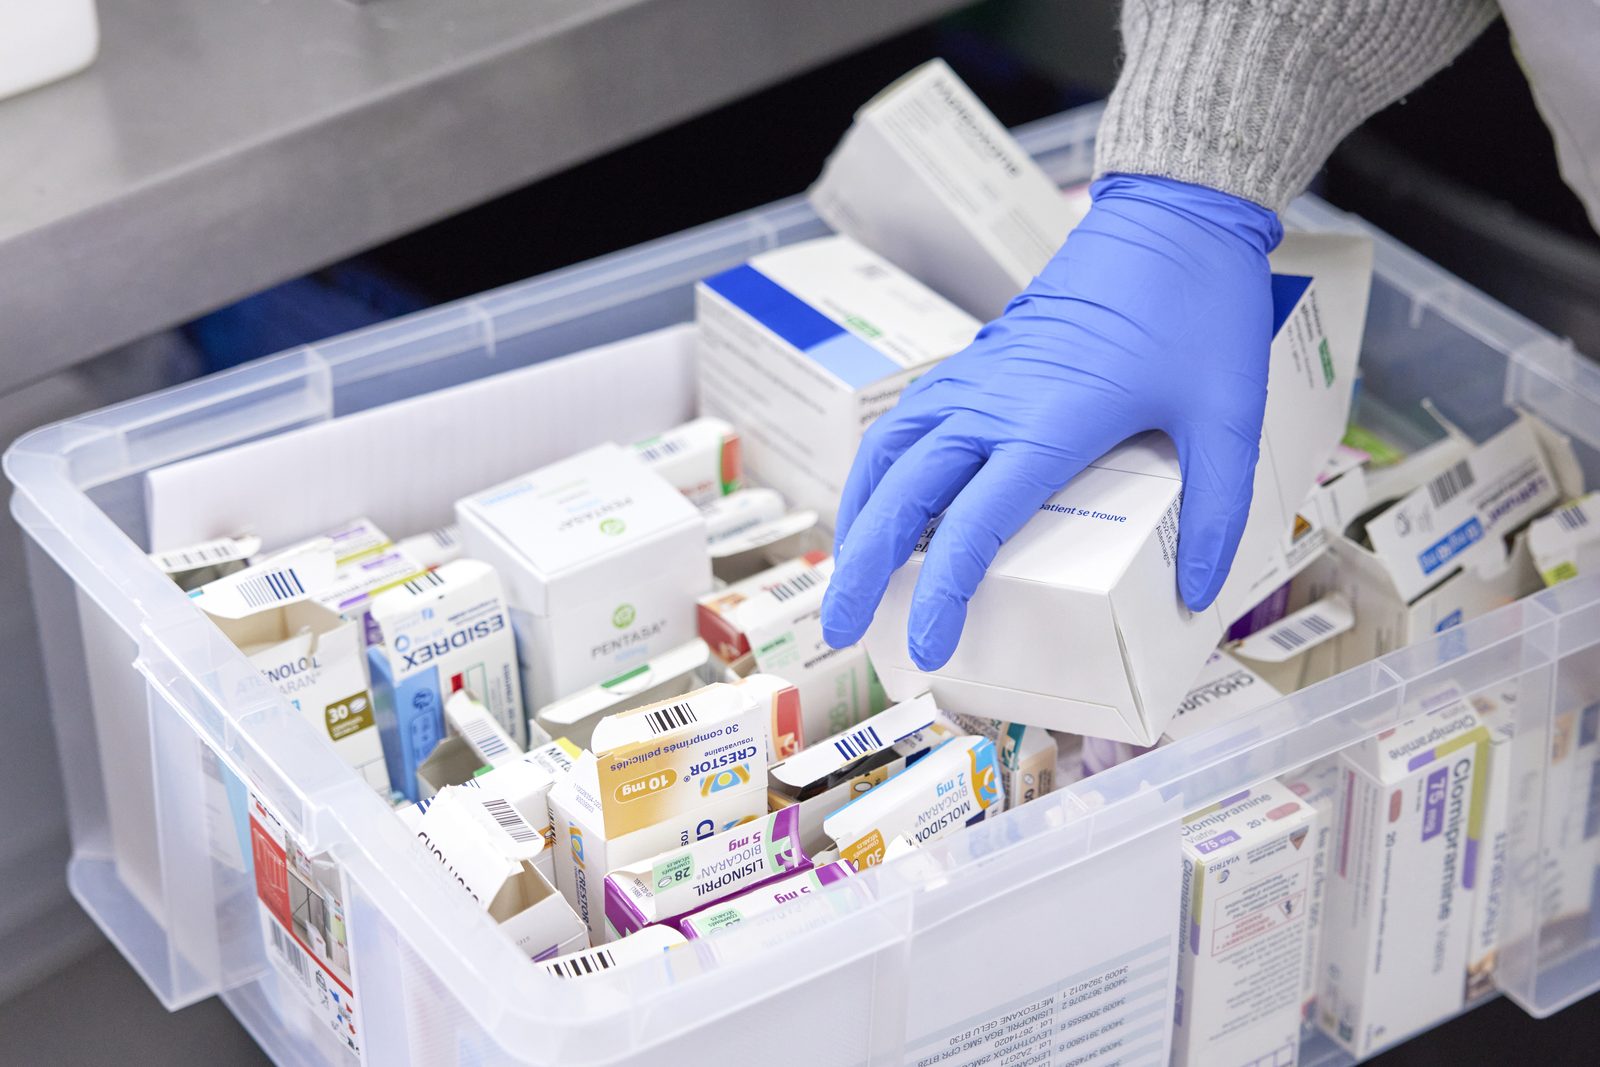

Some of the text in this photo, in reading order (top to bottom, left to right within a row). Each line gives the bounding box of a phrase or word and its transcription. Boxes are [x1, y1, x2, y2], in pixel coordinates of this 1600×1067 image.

[1077, 509, 1090, 517] se
[1092, 511, 1127, 523] trouve
[402, 614, 505, 671] ESIDREX
[328, 704, 348, 724] 30
[726, 723, 739, 735] 30
[663, 730, 723, 753] comprimés
[704, 737, 754, 757] rosuvastatine
[622, 776, 668, 796] 10 mg
[936, 772, 965, 797] 2 mg
[1181, 794, 1272, 836] Clomipramine
[1247, 819, 1261, 829] 20
[729, 832, 761, 852] 5 mg
[1200, 841, 1219, 851] 75
[1438, 758, 1471, 920] Clomipramine
[701, 844, 762, 878] BIOGARAN
[866, 848, 882, 867] 30
[1209, 856, 1240, 873] VIATRIS
[675, 867, 690, 881] 28
[693, 859, 764, 896] LISINOPRIL
[774, 891, 799, 904] mg
[950, 996, 1054, 1046] METEOXANE GELU BT30
[1008, 1007, 1054, 1032] LISINOPRIL
[1040, 1018, 1053, 1029] Lot
[963, 1036, 983, 1048] 5MG
[984, 1028, 1004, 1042] BGA
[993, 1029, 1052, 1059] LEVOTHYROX
[1039, 1039, 1052, 1050] Lot
[942, 1046, 961, 1059] CPR
